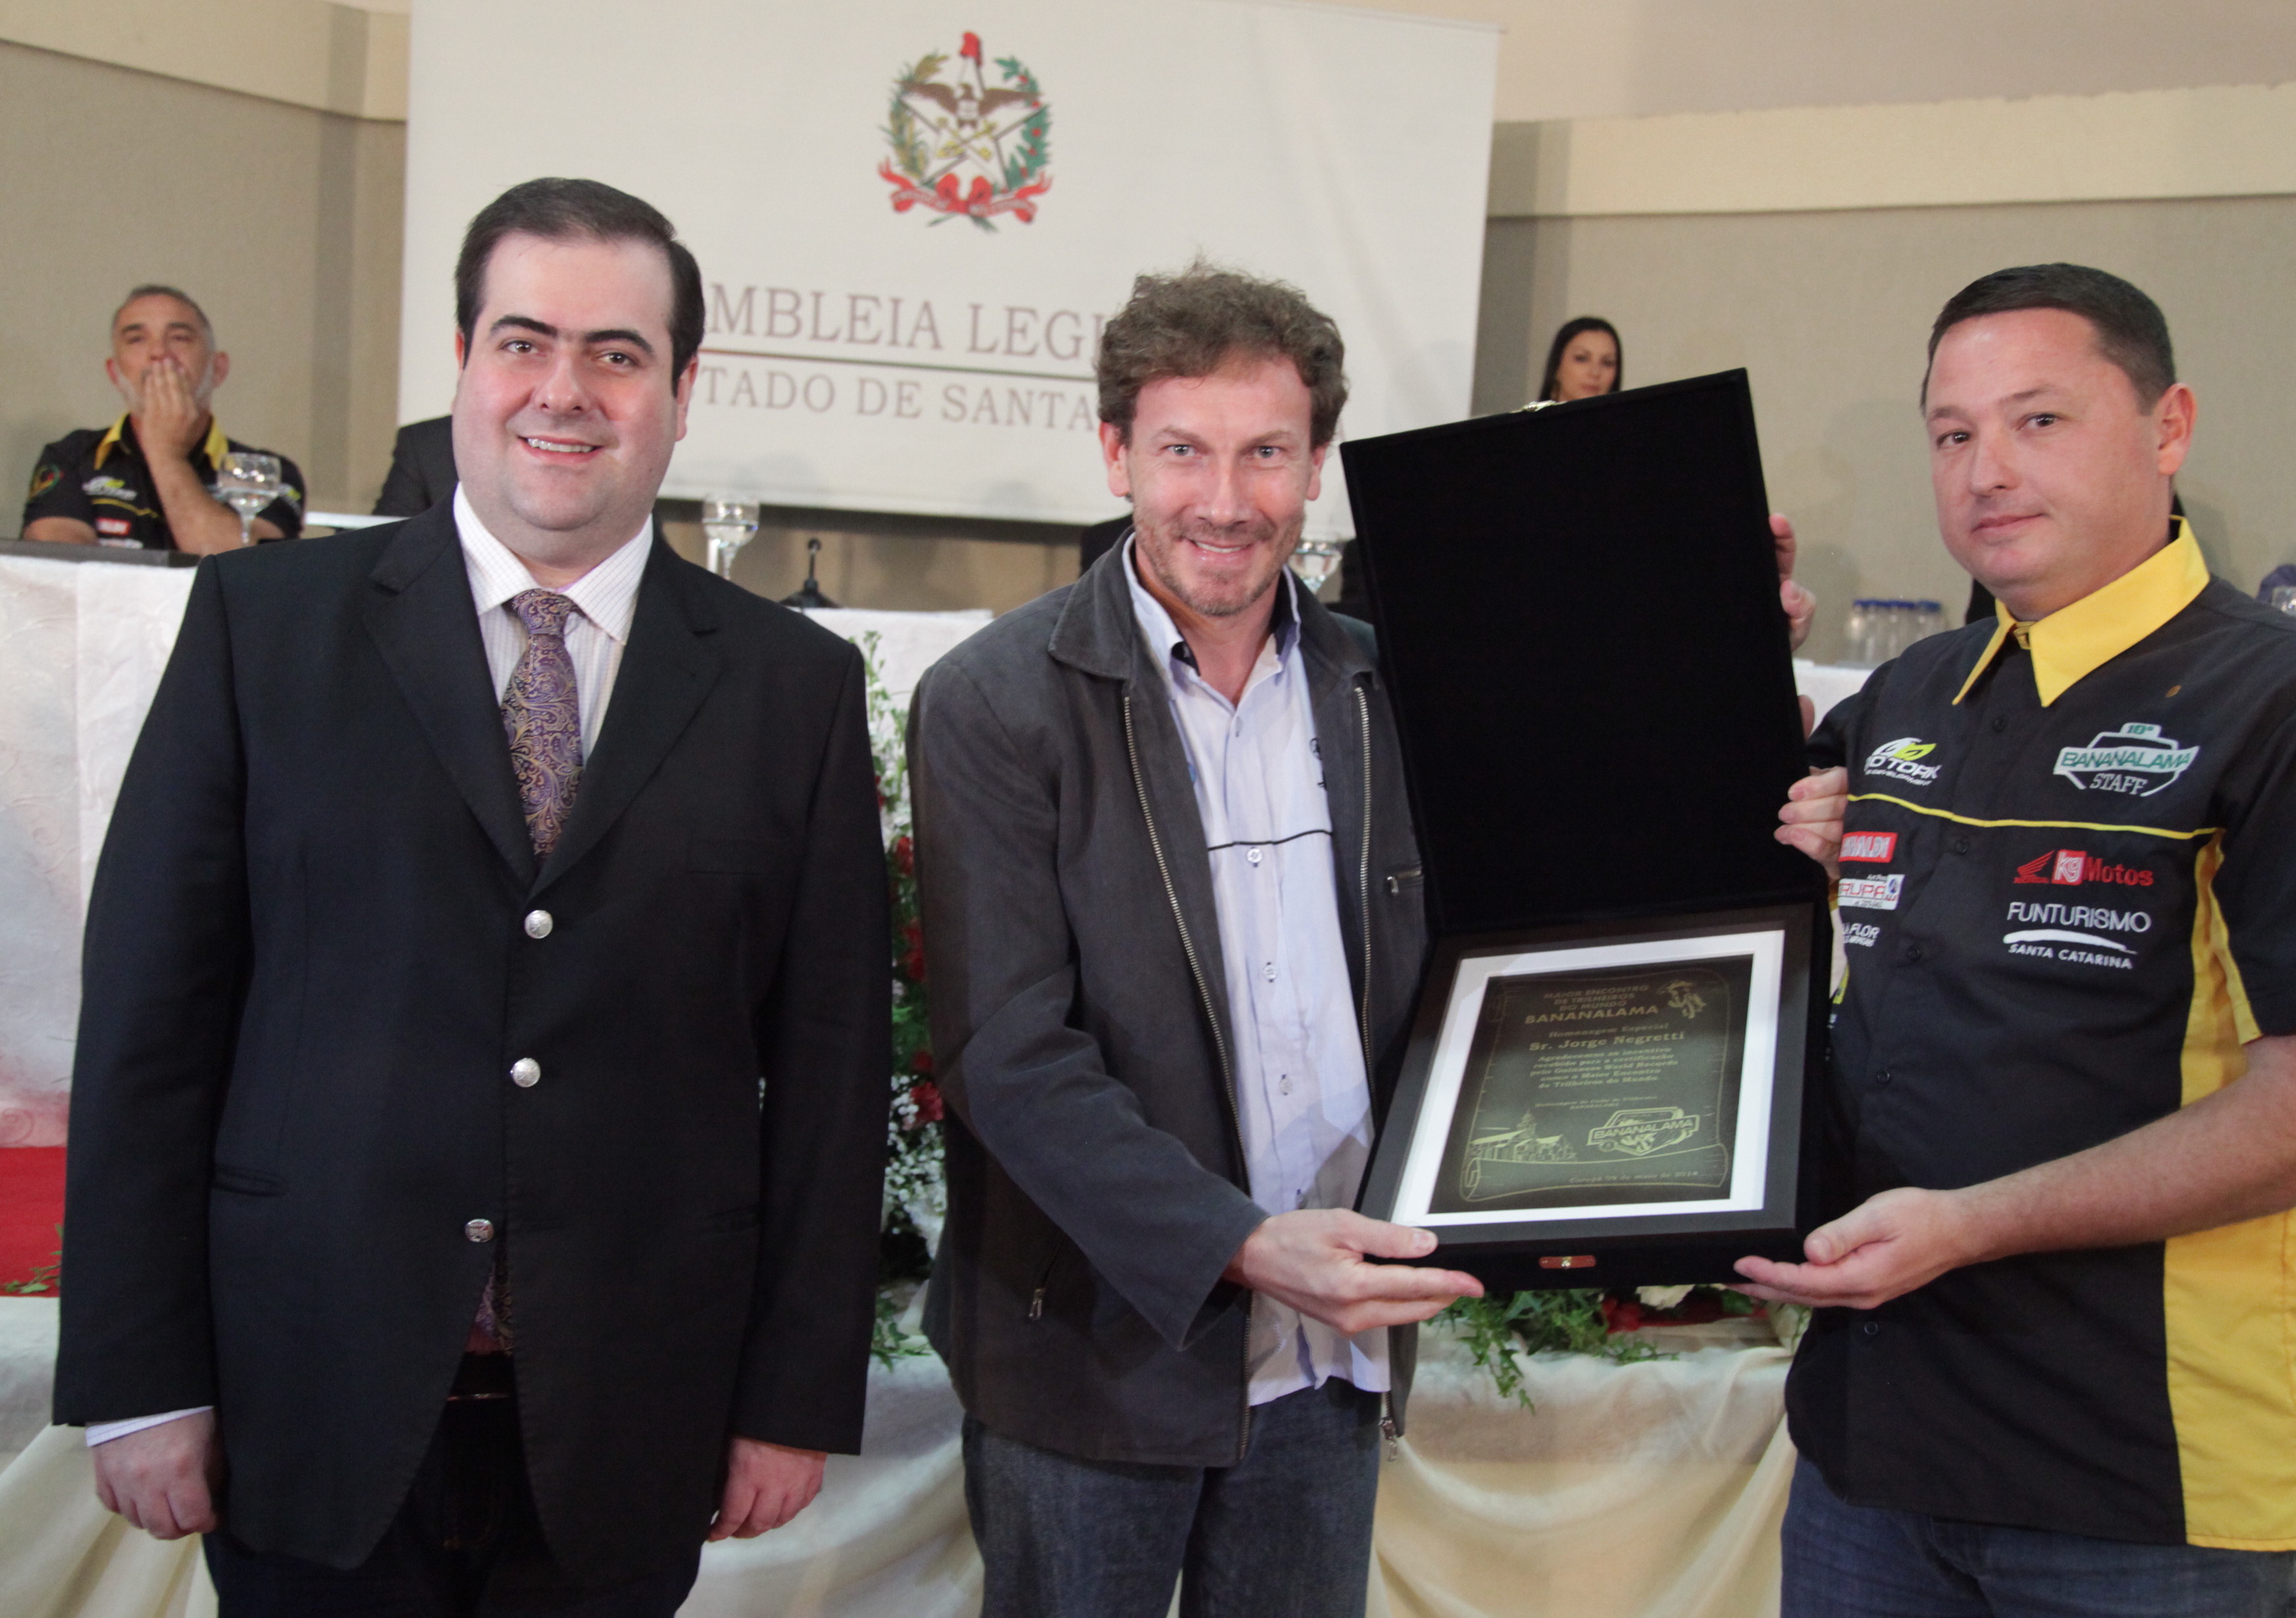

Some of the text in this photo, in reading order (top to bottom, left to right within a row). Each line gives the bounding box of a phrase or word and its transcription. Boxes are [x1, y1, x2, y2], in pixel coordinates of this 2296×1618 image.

[857, 377, 923, 419] DE
[941, 384, 1095, 432] SANTA
[2061, 752, 2191, 770] BANANALAMA
[2089, 773, 2148, 795] STAFF
[2083, 856, 2155, 887] Motos
[2007, 901, 2152, 933] FUNTURISMO
[2008, 944, 2133, 970] SANTA CATARINA
[1525, 1005, 1658, 1024] BANANALAMA
[1529, 1031, 1686, 1051] Sr. Jorge Negretti
[1594, 1119, 1693, 1139] BANANALAMA
